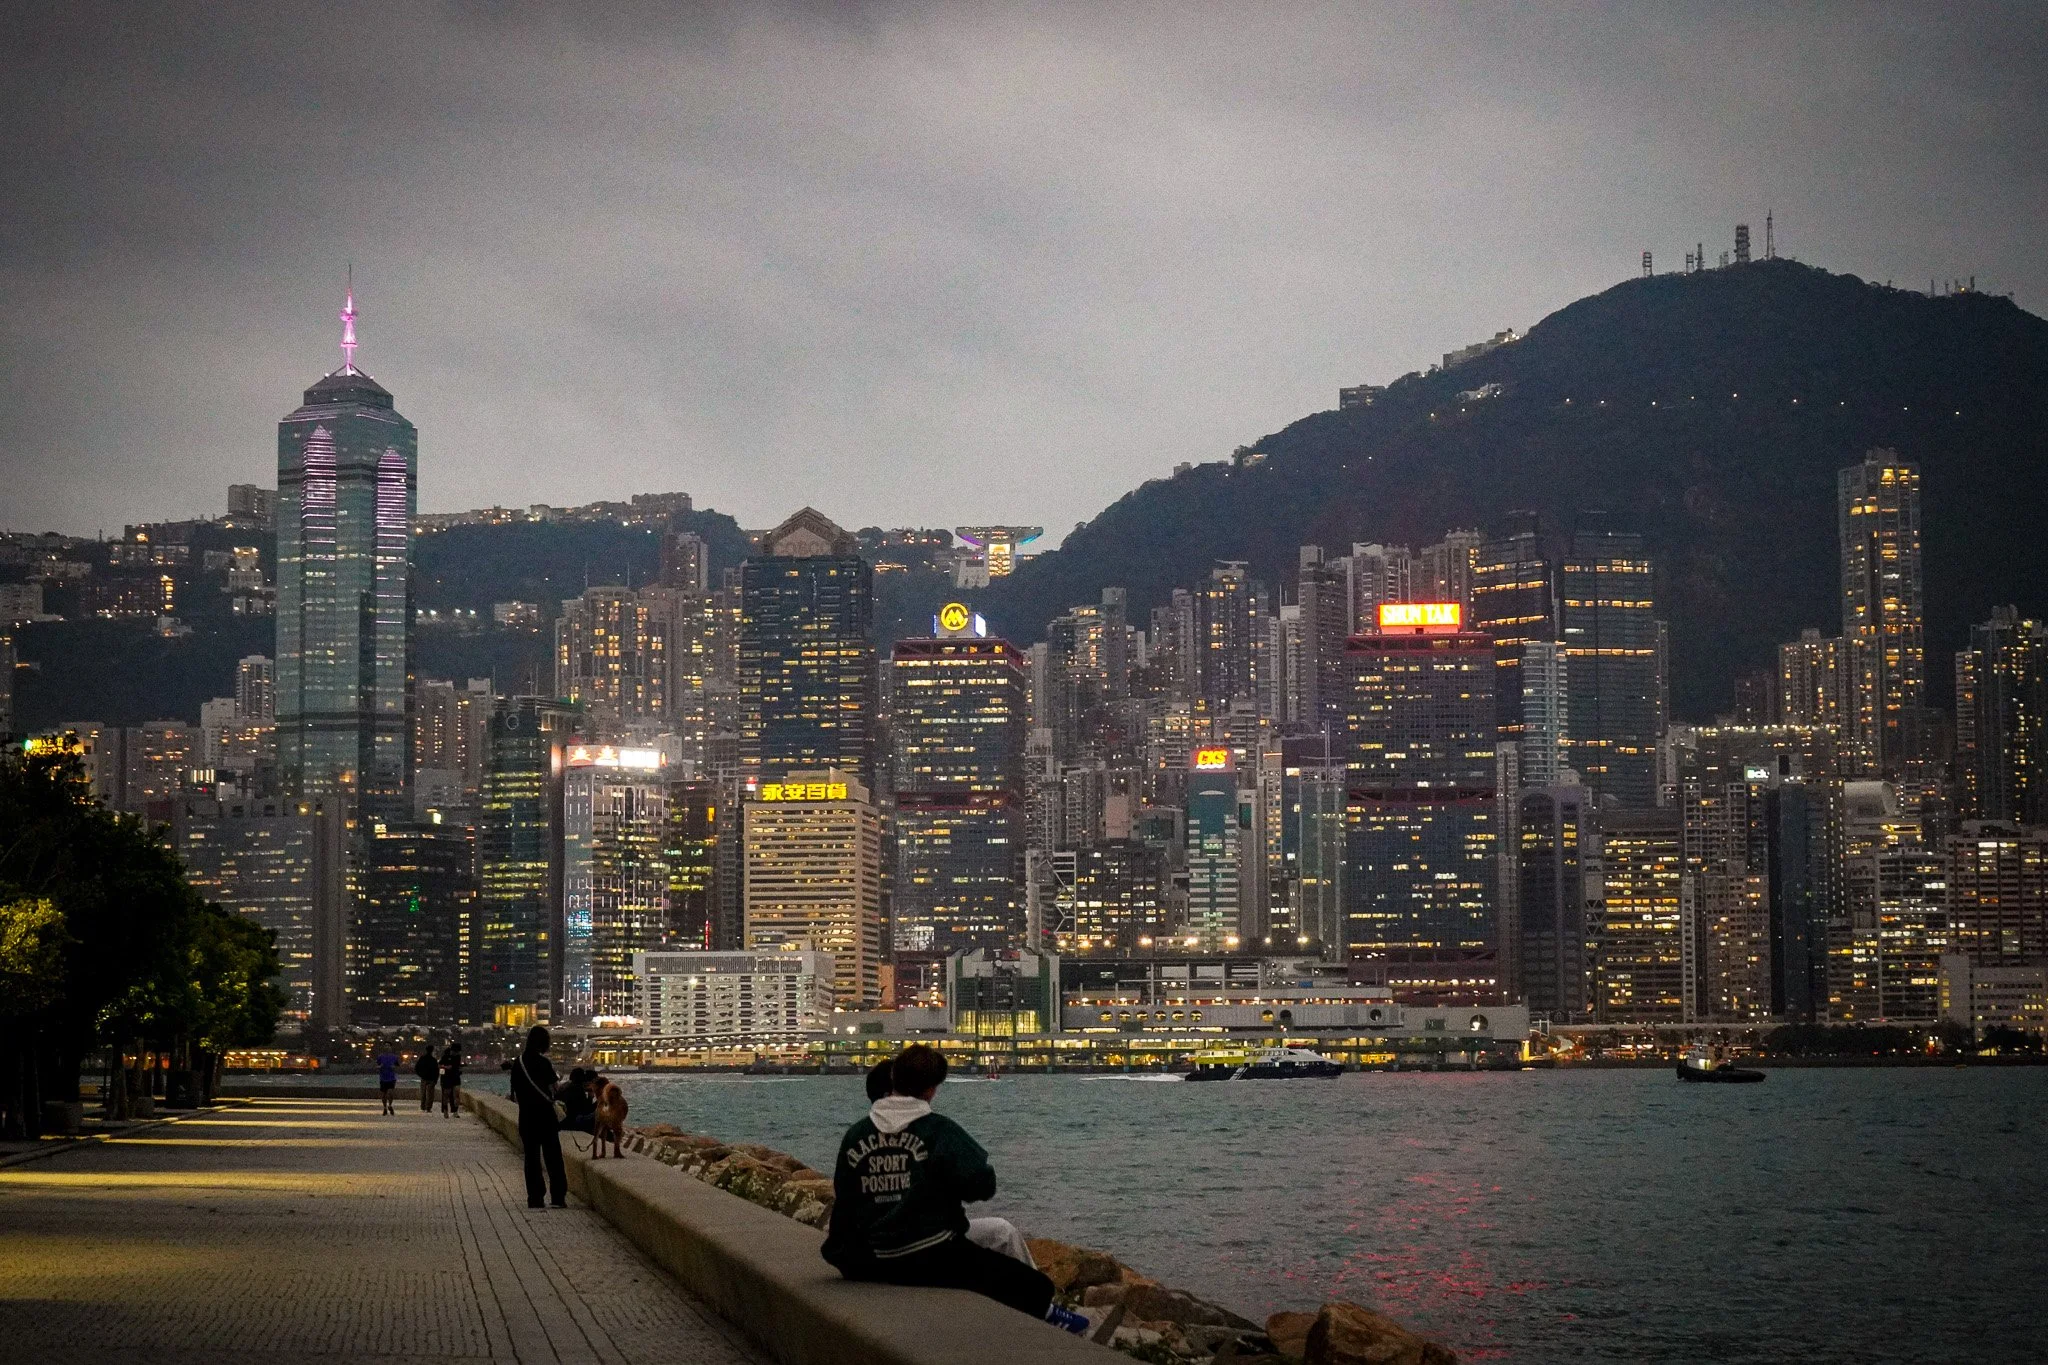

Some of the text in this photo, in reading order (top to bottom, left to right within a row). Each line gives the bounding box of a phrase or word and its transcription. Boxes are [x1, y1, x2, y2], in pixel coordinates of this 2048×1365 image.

[1383, 604, 1456, 624] SHUN TAK
[763, 784, 847, 800] 永安百貨
[868, 1154, 908, 1173] SPORT
